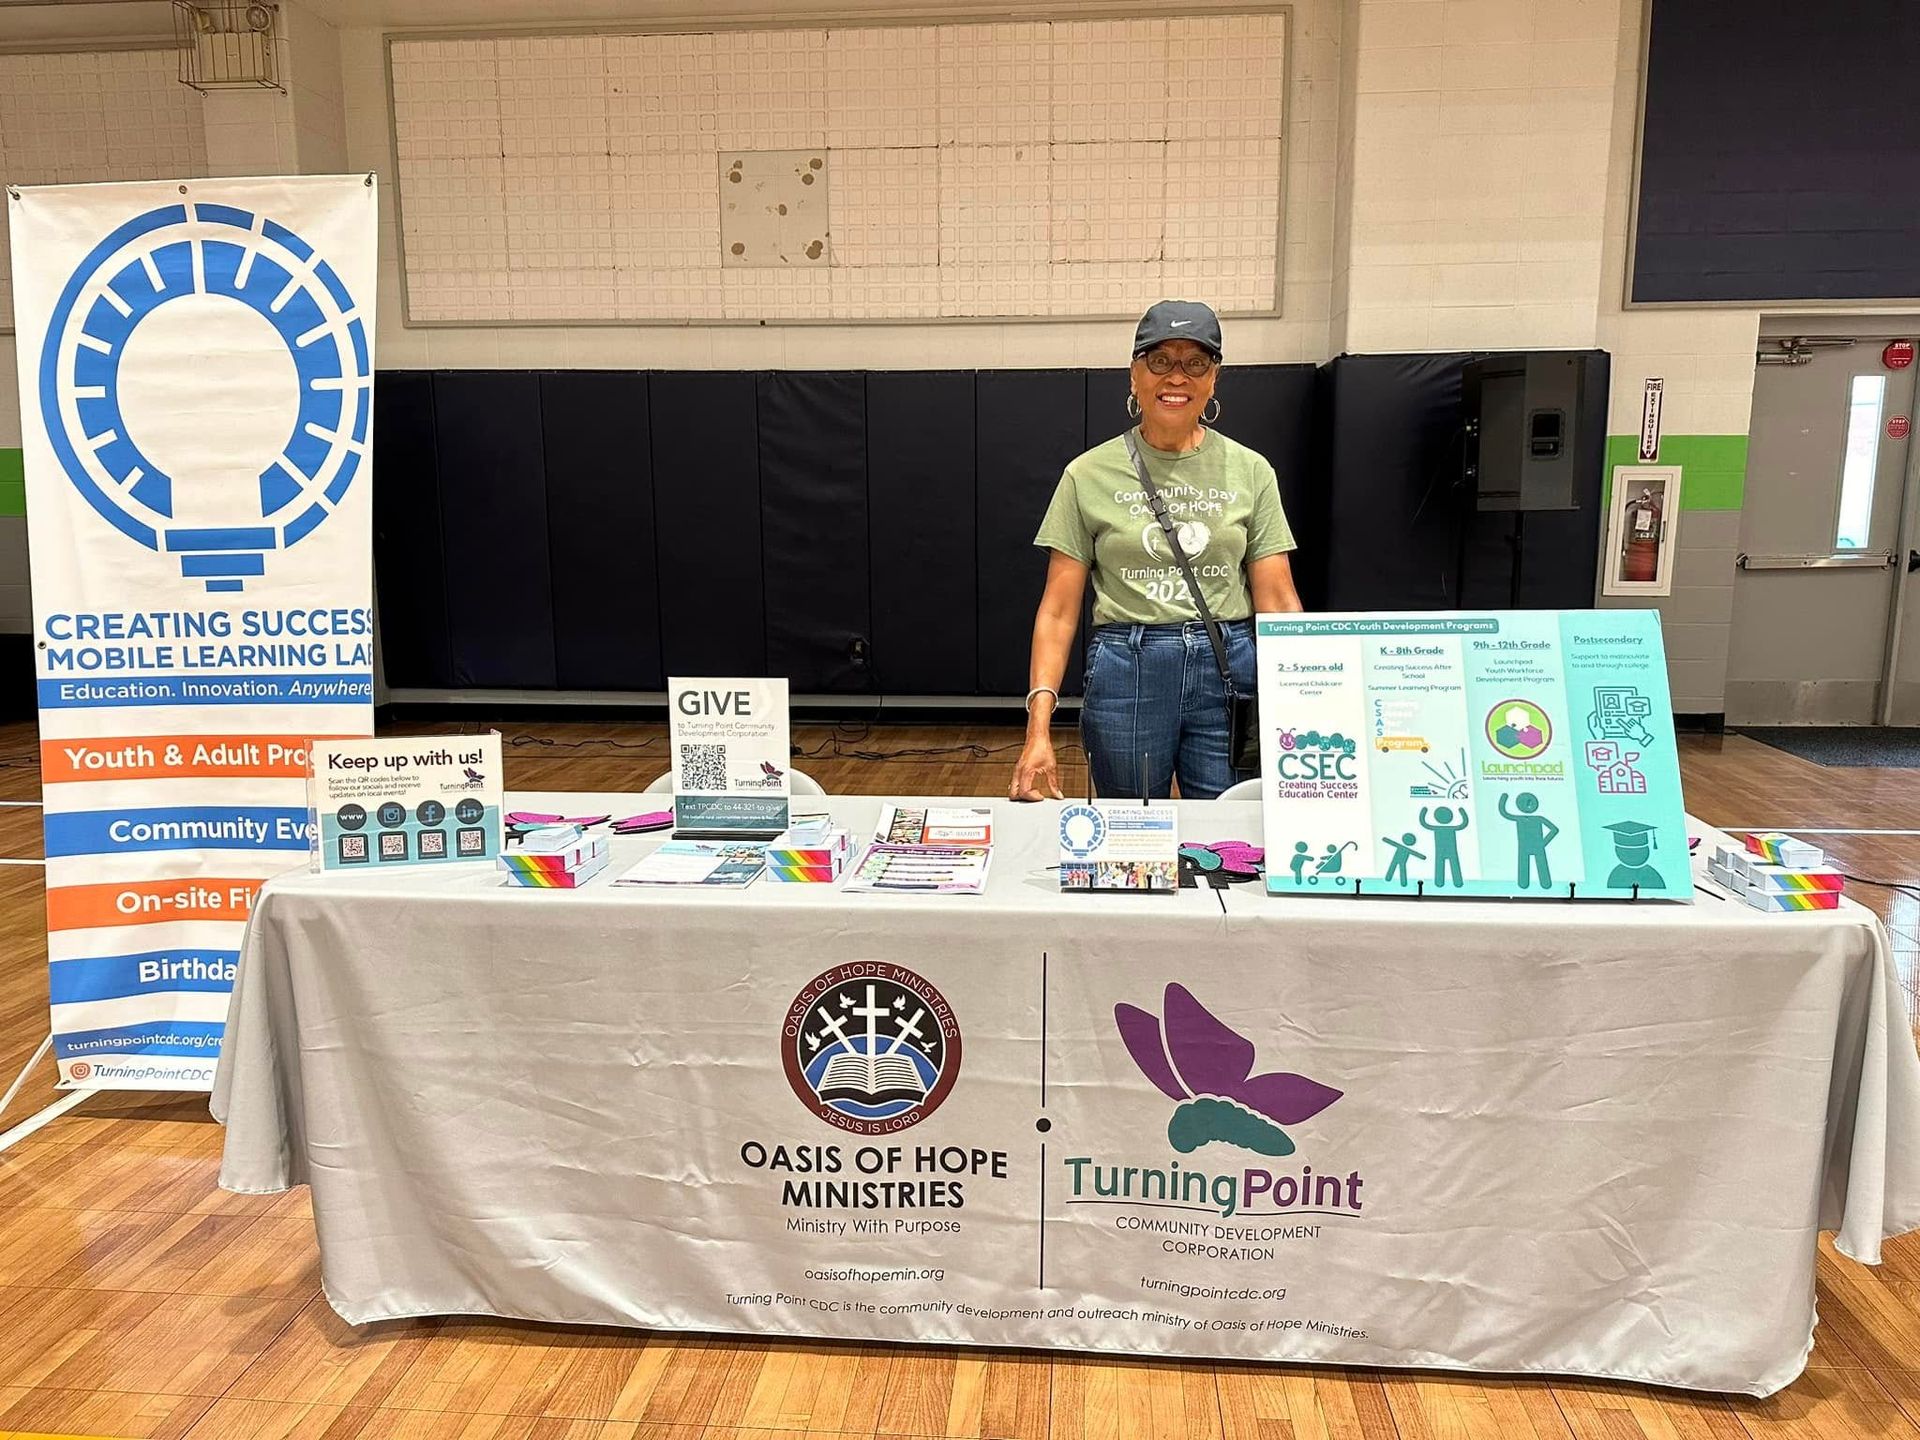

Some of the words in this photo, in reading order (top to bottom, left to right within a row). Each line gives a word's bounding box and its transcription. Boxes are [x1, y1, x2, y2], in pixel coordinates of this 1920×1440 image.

[1647, 383, 1661, 391] FIRE
[1208, 488, 1238, 505] Day
[1168, 502, 1187, 514] OF
[1189, 500, 1223, 512] HOPE
[1120, 567, 1165, 579] Turning
[1168, 566, 1198, 577] Pot
[1202, 565, 1229, 577] CDC
[1145, 579, 1197, 603] 202
[45, 611, 231, 640] CREATING
[1268, 622, 1304, 632] Turning
[1305, 621, 1329, 631] Point
[1331, 621, 1352, 630] CDC
[1353, 621, 1381, 630] Youth
[1383, 621, 1445, 632] Development
[1446, 621, 1494, 631] Programs
[1473, 641, 1489, 650] 9th
[1498, 640, 1518, 650] 12th
[1519, 640, 1551, 650] Grade
[1573, 635, 1643, 645] Postsecondary
[47, 646, 174, 671] MOBILE
[183, 643, 327, 669] LEARNING
[1380, 647, 1388, 655] K
[1396, 646, 1413, 655] 8th
[1414, 646, 1444, 655] Grade
[1570, 653, 1599, 661] Support
[1278, 664, 1285, 672] 2
[1293, 663, 1299, 671] 5
[1300, 664, 1330, 673] years
[1331, 662, 1343, 671] old
[1374, 664, 1404, 672] Creating
[1493, 658, 1533, 666] Launchpad
[1595, 661, 1624, 670] through
[1475, 675, 1522, 684] Development
[1523, 675, 1555, 684] Program
[60, 682, 176, 701] Education.
[182, 680, 283, 698] Innovation.
[1398, 684, 1429, 692] Learning
[1430, 684, 1462, 692] Program
[678, 690, 751, 716] GIVE
[687, 721, 714, 730] Turning
[715, 721, 733, 729] Point
[735, 721, 775, 731] Community
[678, 730, 725, 738] Development
[726, 730, 768, 738] Corporation
[64, 744, 154, 770] Youth
[164, 745, 184, 766] &
[192, 743, 259, 767] Adult
[328, 752, 379, 773] Keep
[384, 755, 408, 772] up
[413, 750, 453, 767] with
[458, 748, 483, 765] us!
[1277, 752, 1357, 781] CSEC
[1481, 761, 1564, 776] Launchpad
[440, 781, 484, 791] TurningPoint
[735, 778, 782, 788] TurningPoint
[1279, 780, 1317, 791] Creating
[1320, 780, 1358, 790] Success
[329, 792, 356, 800] updates
[1278, 789, 1326, 798] Education
[1327, 789, 1358, 799] Center
[697, 803, 723, 811] TPCDC
[340, 812, 364, 821] www
[109, 818, 269, 845] Community
[116, 887, 222, 914] On-site
[229, 886, 257, 909] Fi
[784, 989, 815, 1038] OASIS
[813, 972, 835, 992] OF
[839, 963, 887, 980] HOPE
[891, 967, 959, 1039] MINISTRIES
[93, 1063, 213, 1082] TurningPointCDC
[820, 1108, 864, 1134] JESUS
[868, 1121, 881, 1134] IS
[884, 1110, 920, 1133] LORD
[740, 1141, 843, 1173] OASIS
[855, 1146, 902, 1174] OF
[915, 1146, 1008, 1179] HOPE
[782, 1180, 965, 1210] MINISTRIES
[1063, 1157, 1364, 1218] TurningPoint
[786, 1217, 847, 1236] Ministry
[852, 1218, 888, 1234] With
[895, 1219, 961, 1236] Purpose
[1115, 1215, 1210, 1237] COMMUNITY
[1214, 1225, 1321, 1242] DEVELOPMENT
[1162, 1239, 1275, 1261] CORPORATION
[804, 1267, 945, 1284] oasisofhopemin.org
[1140, 1276, 1287, 1300] turningpointcdc.org
[725, 1292, 772, 1307] Turning
[775, 1292, 806, 1306] Point
[809, 1299, 839, 1312] CDC
[843, 1300, 851, 1311] is
[855, 1301, 876, 1314] the
[879, 1299, 954, 1316] community
[956, 1303, 1044, 1321] development
[1047, 1307, 1074, 1320] and
[1077, 1307, 1139, 1322] outreach
[1142, 1309, 1191, 1331] ministry
[1193, 1318, 1208, 1331] of
[1211, 1318, 1247, 1332] Oasis
[1250, 1318, 1265, 1332] of
[1266, 1318, 1303, 1333] Hope
[1305, 1319, 1370, 1339] Ministries.
